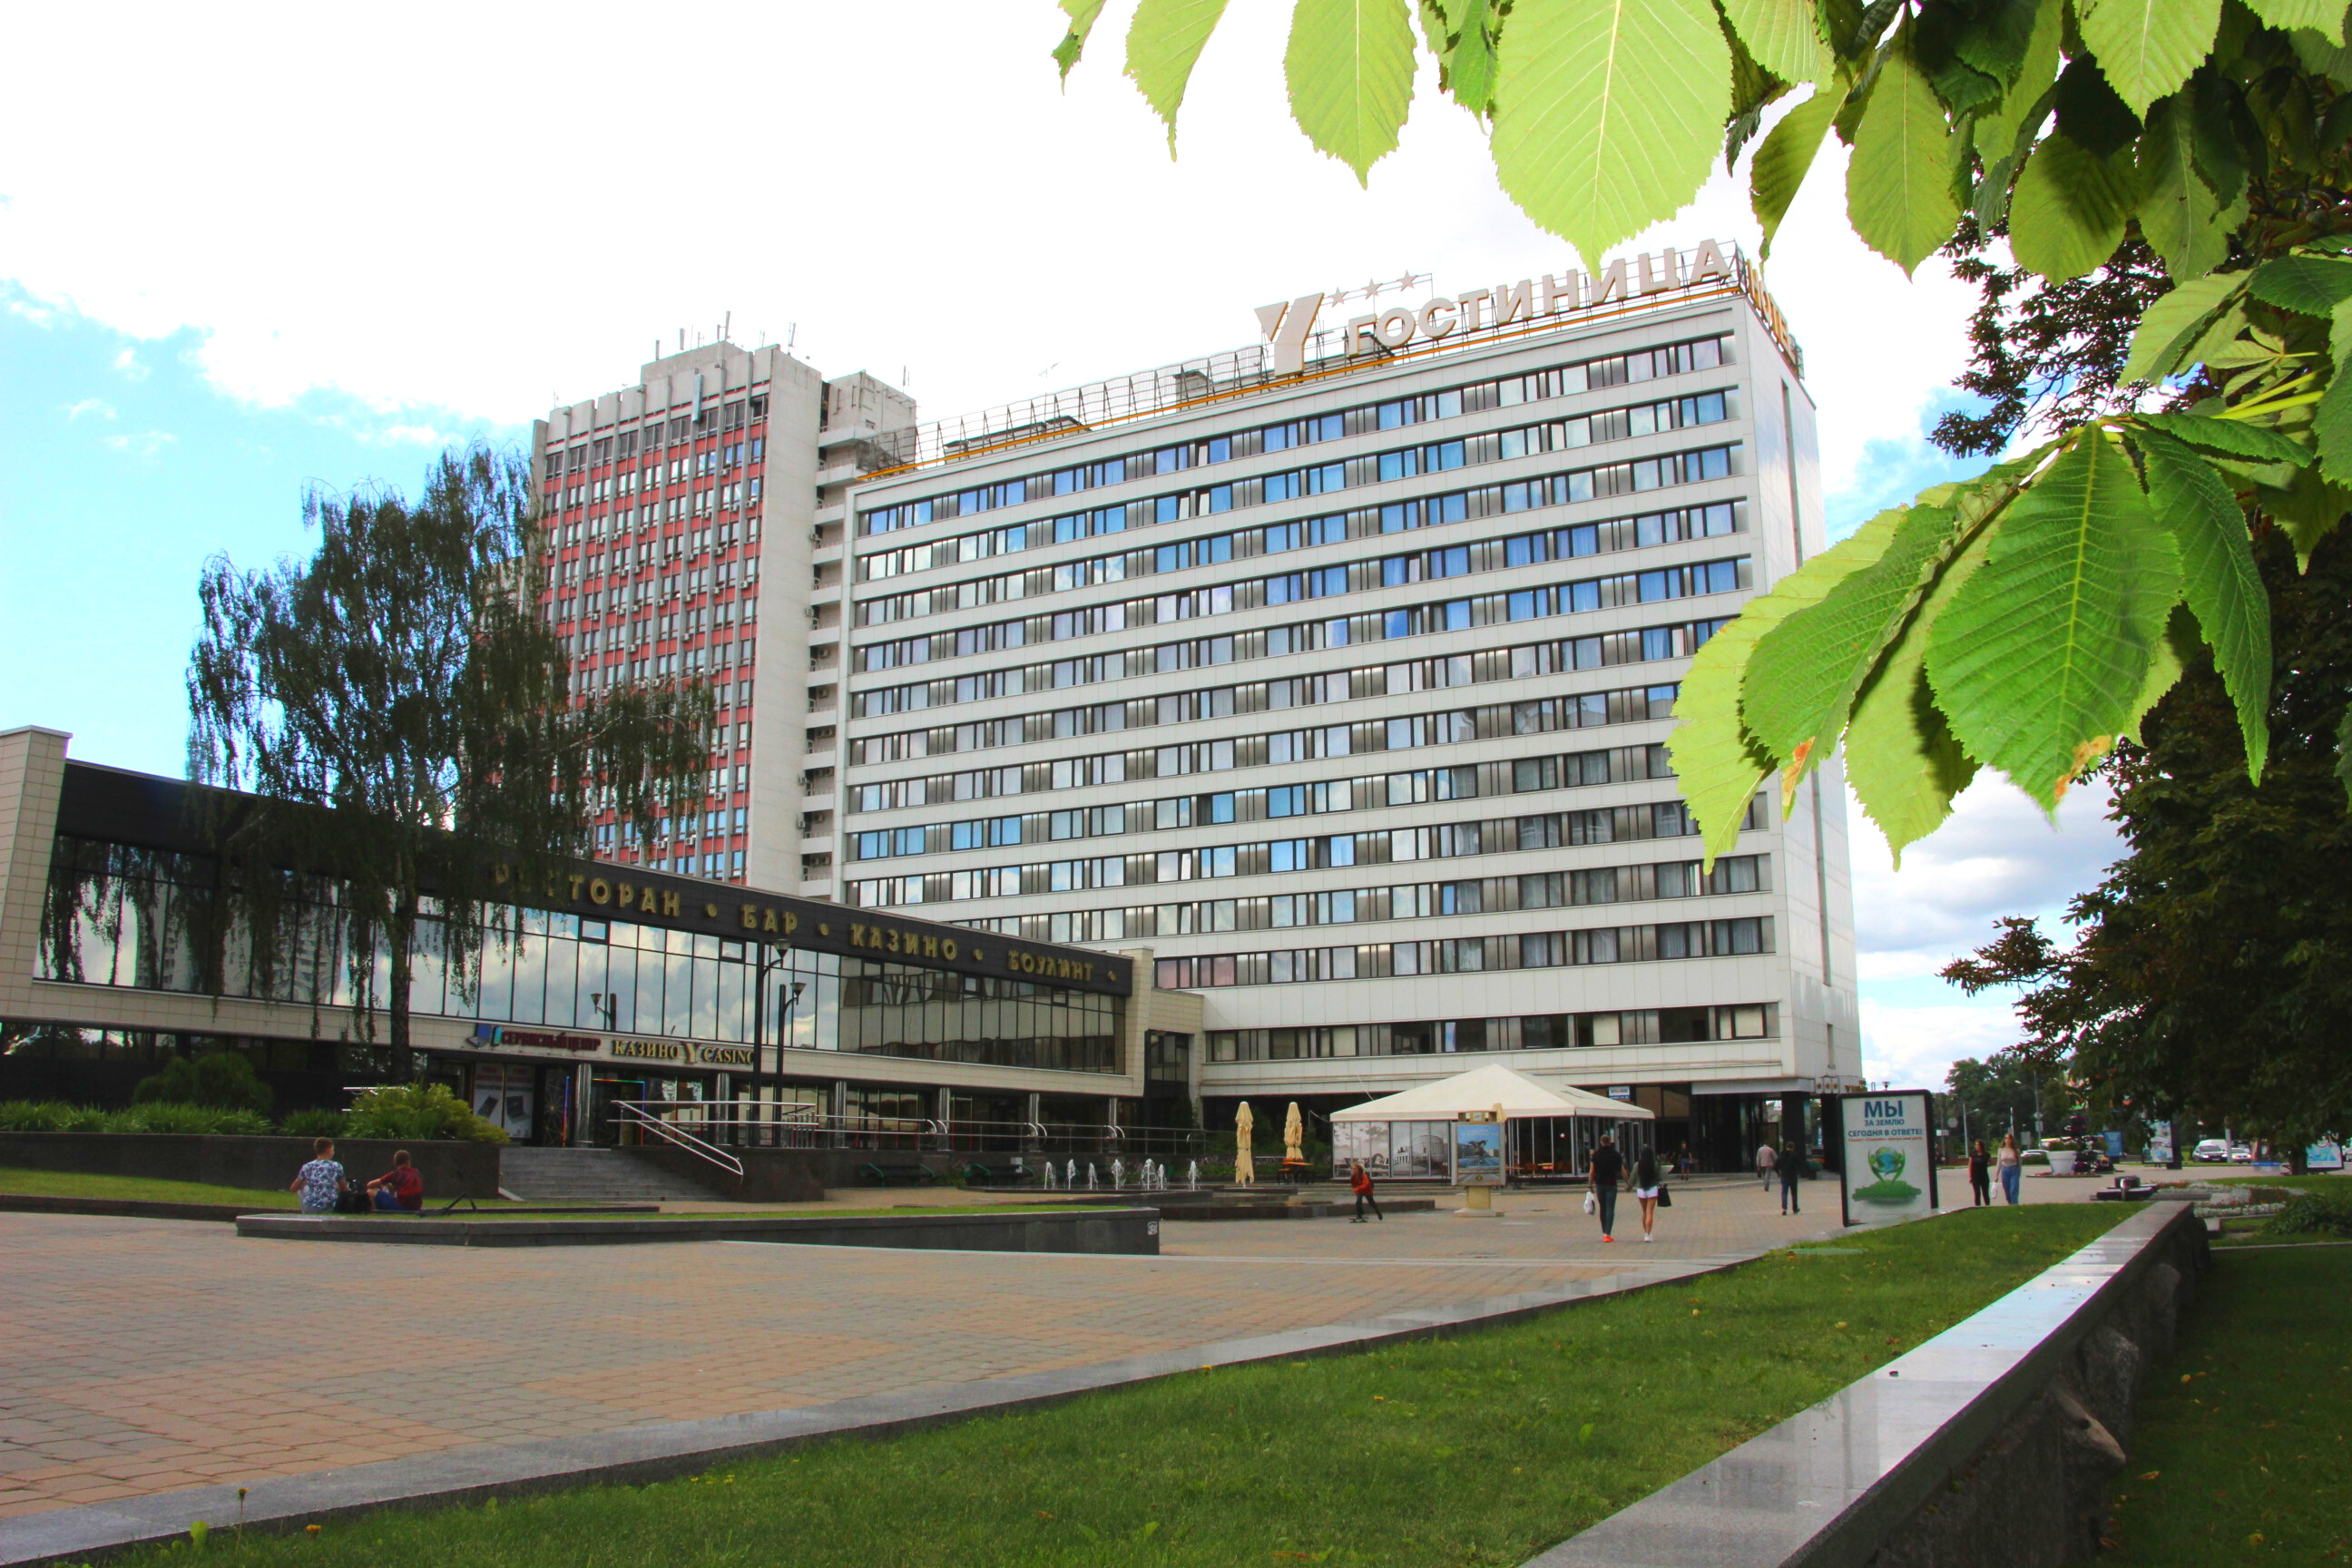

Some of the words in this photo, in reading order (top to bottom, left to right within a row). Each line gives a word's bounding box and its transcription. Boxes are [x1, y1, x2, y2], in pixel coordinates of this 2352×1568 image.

[1348, 238, 1732, 359] ГОСТИНИЦА
[740, 904, 798, 935] БАР
[850, 923, 957, 961] КАЗИНО
[613, 1040, 681, 1060] КАЗИНО
[1864, 1100, 1904, 1118] МЫ
[1877, 1118, 1905, 1126] ЗЕМЛЮ
[1847, 1129, 1883, 1137] СЕГОДНЯ
